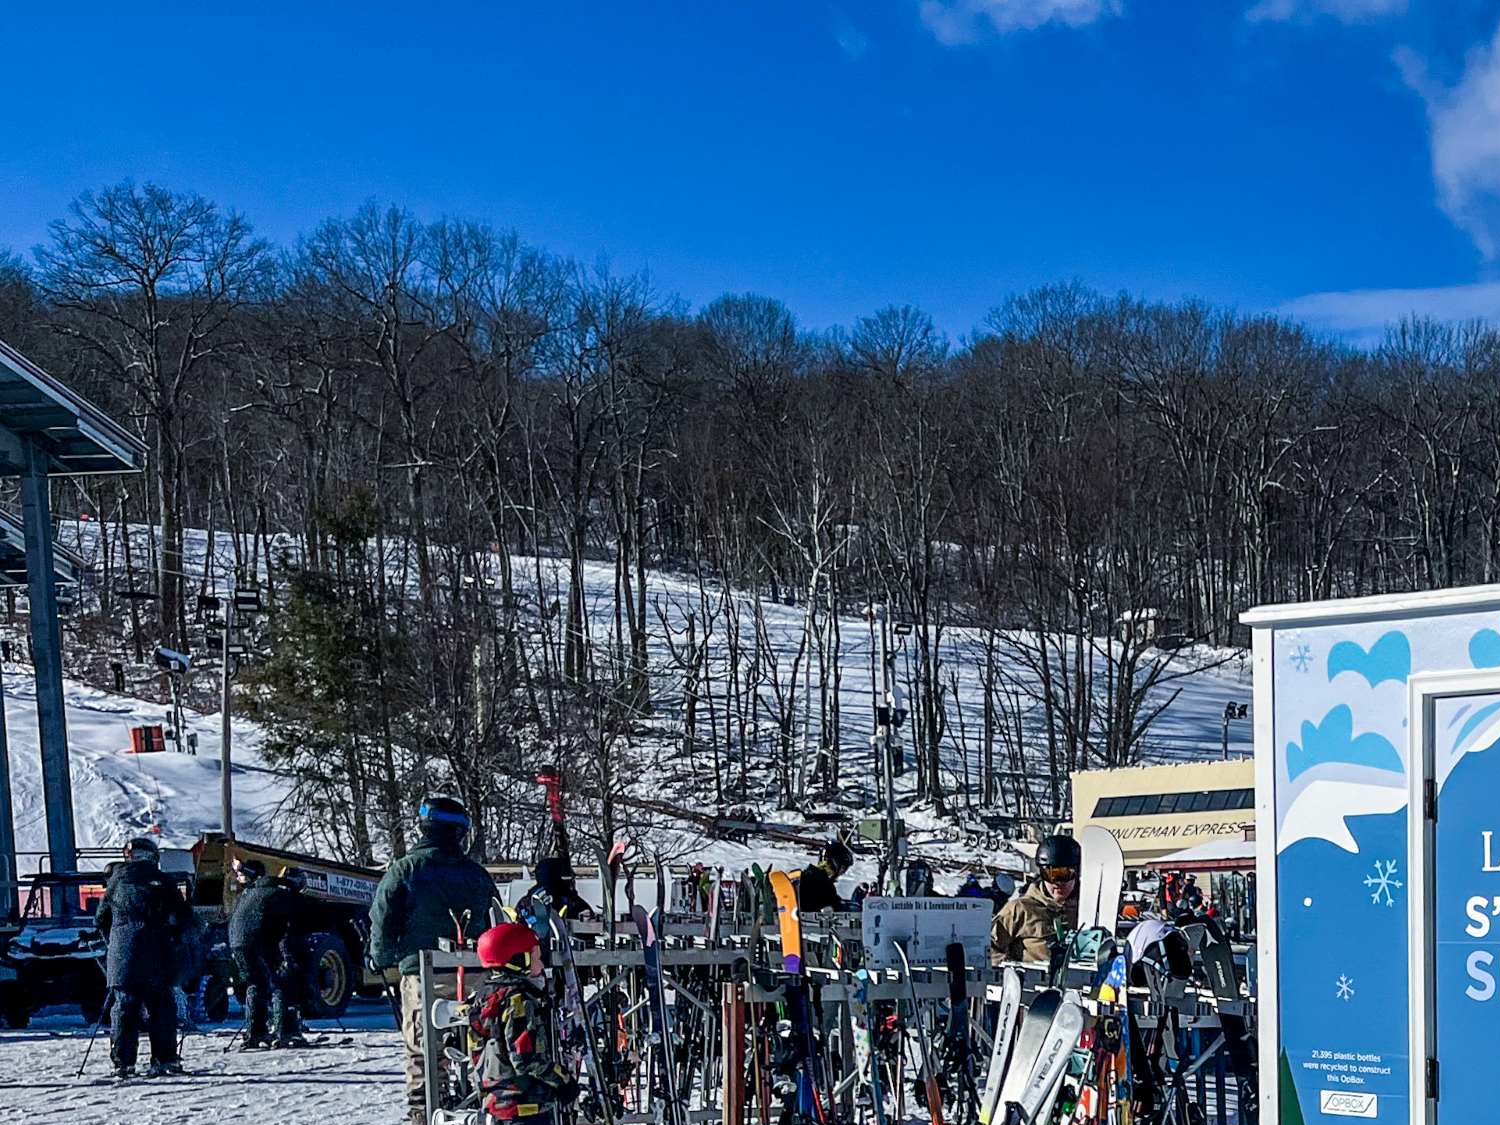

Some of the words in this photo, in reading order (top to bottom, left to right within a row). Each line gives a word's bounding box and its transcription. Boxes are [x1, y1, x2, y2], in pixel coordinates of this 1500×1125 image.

[1183, 822, 1246, 837] EXPRESS
[997, 1002, 1011, 1056] HEAD
[1033, 1038, 1063, 1088] HEAD
[1334, 1052, 1355, 1061] plastic
[1357, 1053, 1381, 1063] bottles
[1303, 1062, 1319, 1070] were
[1320, 1063, 1348, 1073] recycled
[1350, 1065, 1357, 1073] to
[1359, 1066, 1391, 1075] construct
[1327, 1074, 1339, 1082] this
[1332, 1096, 1364, 1110] OPBOX
